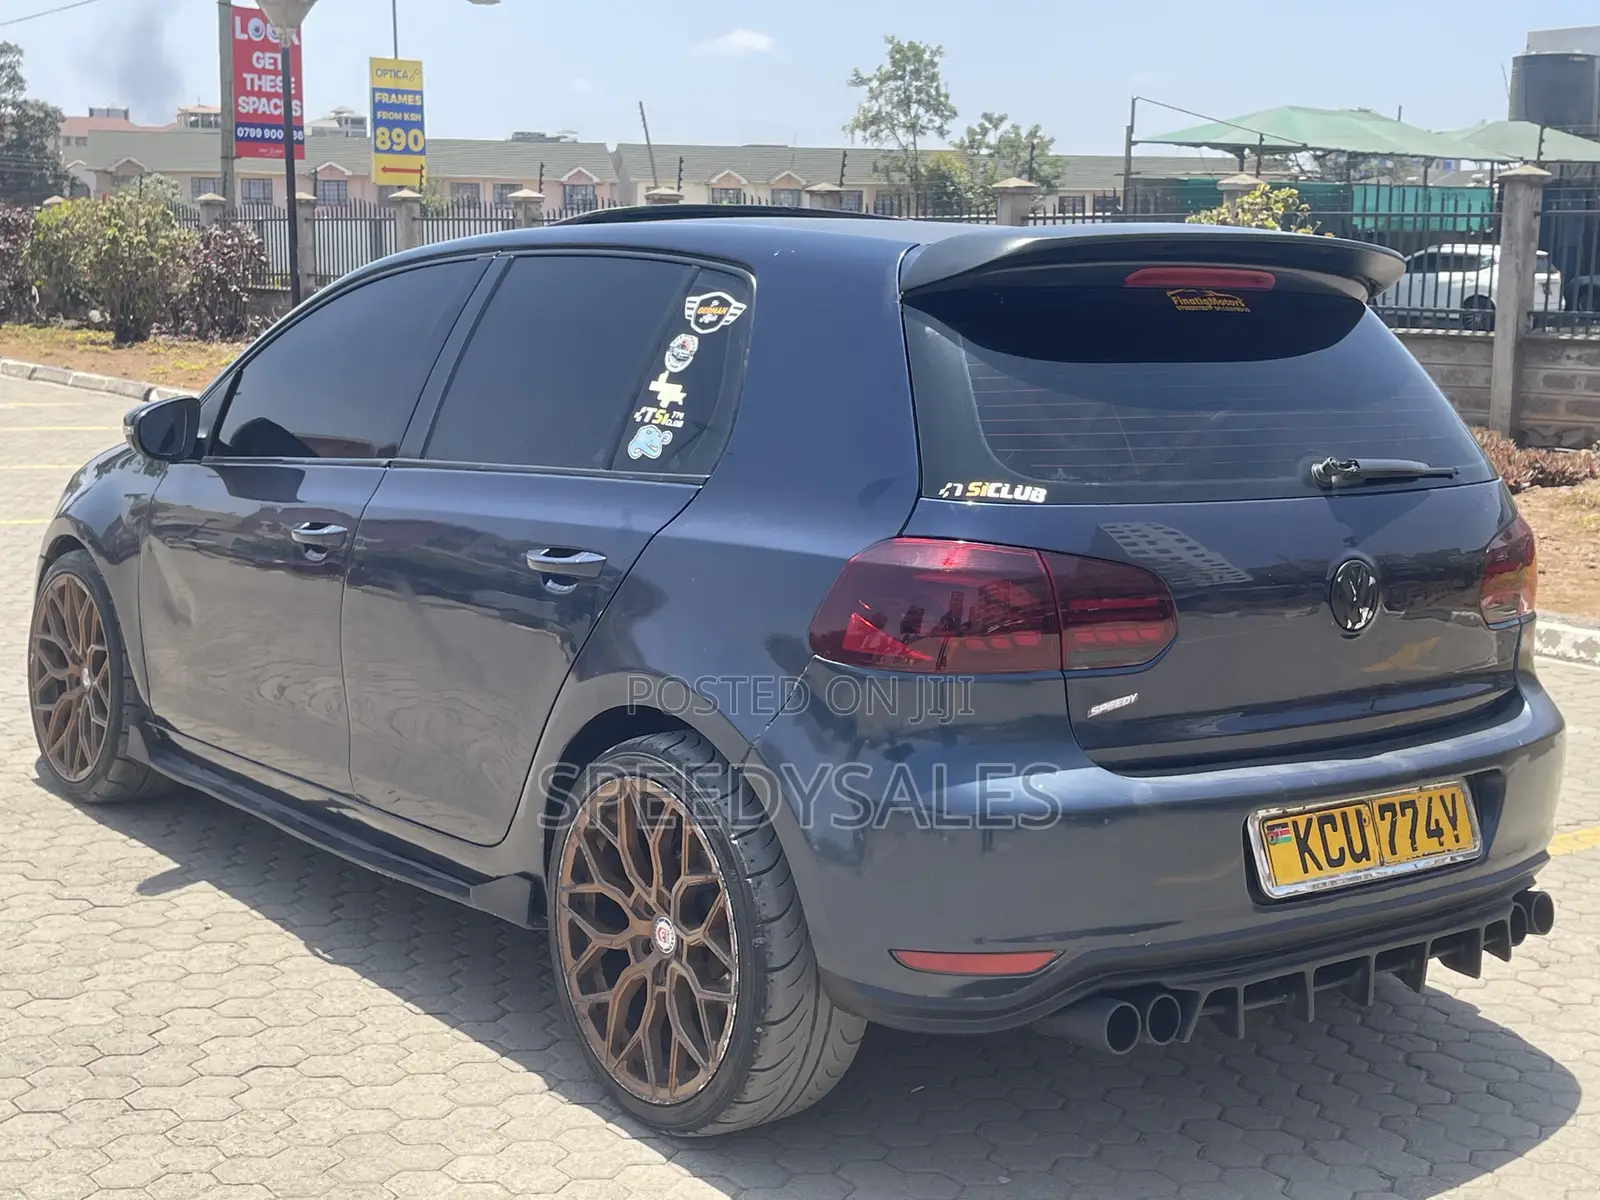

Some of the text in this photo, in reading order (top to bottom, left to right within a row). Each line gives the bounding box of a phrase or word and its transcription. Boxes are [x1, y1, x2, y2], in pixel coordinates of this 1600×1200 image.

[252, 51, 282, 70] GET
[376, 68, 408, 79] OPTICA
[238, 96, 301, 117] SPACS
[375, 92, 422, 105] FRAMES
[377, 111, 421, 122] FROM KSH
[375, 127, 424, 152] 890
[1087, 692, 1138, 718] SPEEDY
[1292, 792, 1460, 874] KCU 774Y
